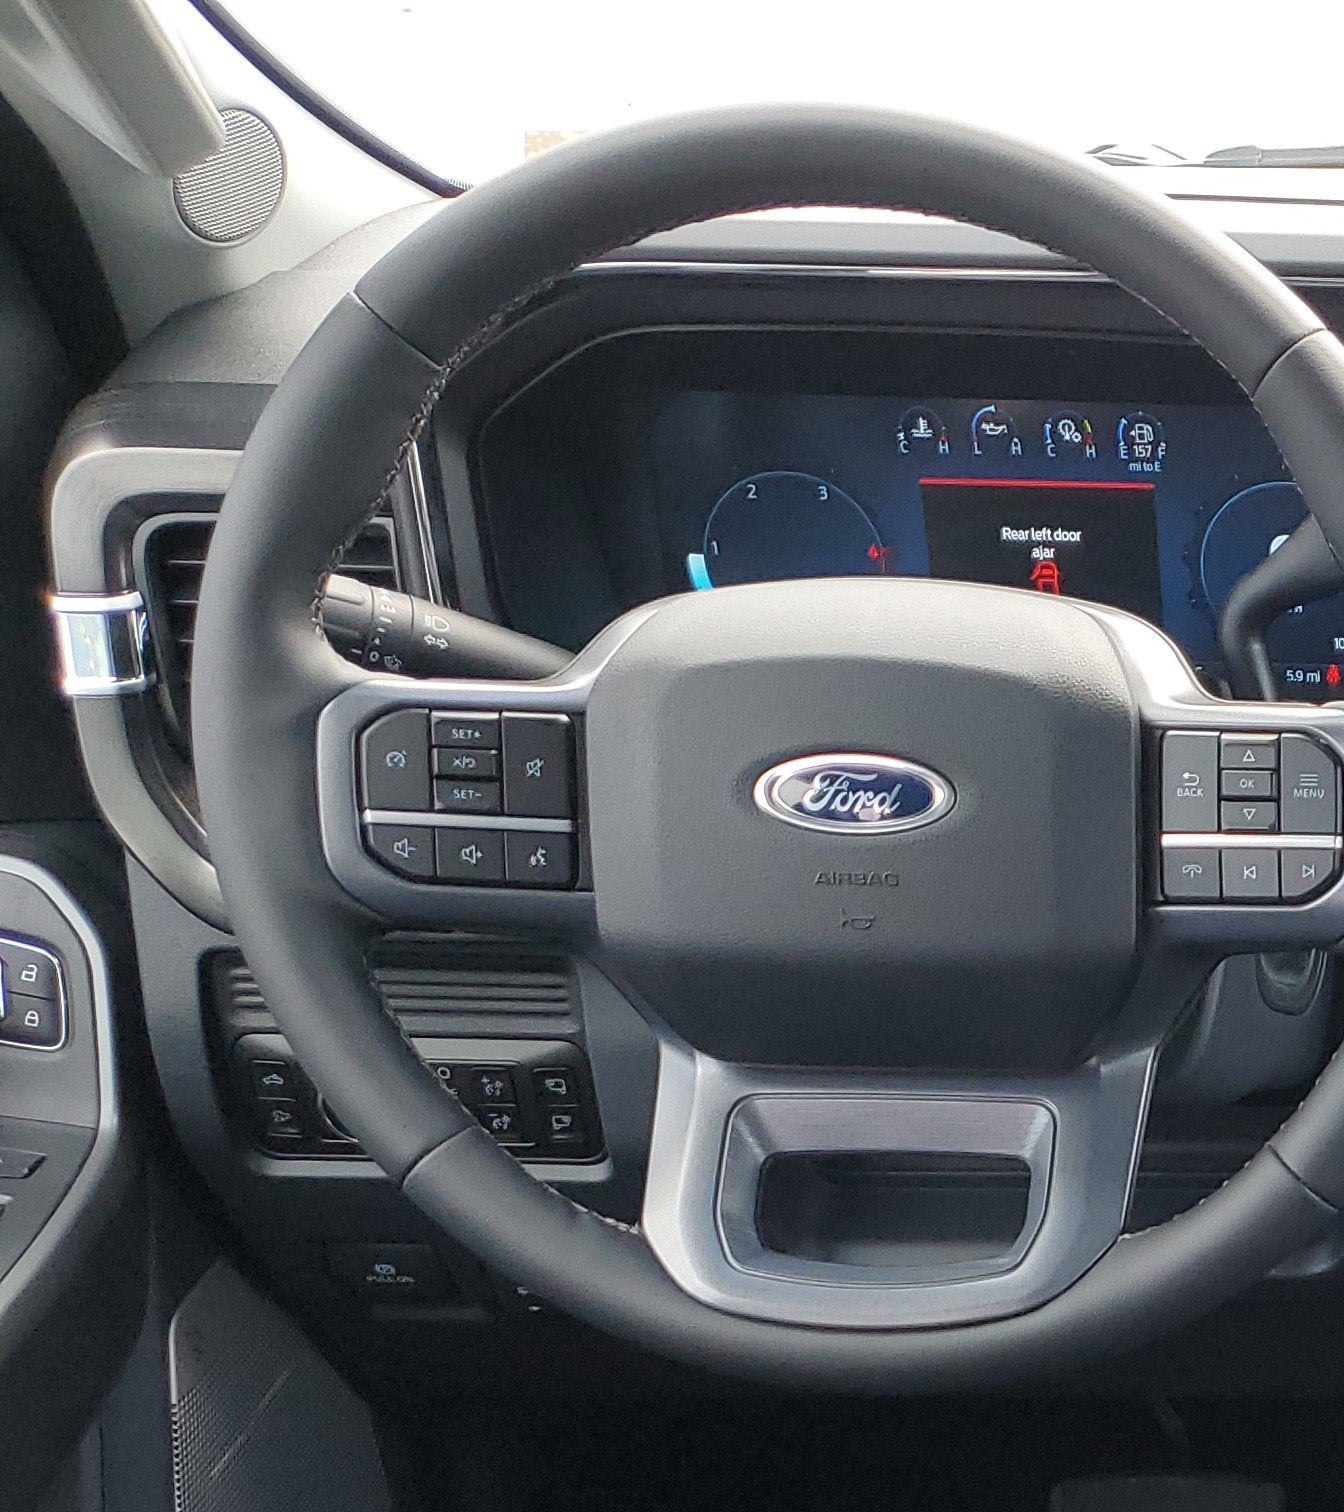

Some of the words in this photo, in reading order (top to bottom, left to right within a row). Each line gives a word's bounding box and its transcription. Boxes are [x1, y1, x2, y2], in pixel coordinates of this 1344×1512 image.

[1119, 446, 1129, 459] E
[1132, 444, 1152, 458] 157
[1143, 462, 1154, 471] to
[1154, 462, 1162, 472] E
[746, 484, 758, 500] 2
[817, 486, 829, 501] 3
[1001, 526, 1030, 541] Rear
[1031, 526, 1053, 542] left
[1053, 526, 1082, 542] door
[711, 540, 719, 556] 1
[1031, 545, 1056, 560] ajar
[1285, 669, 1304, 682] 5.9
[1306, 669, 1321, 684] mi
[1239, 778, 1255, 788] OK
[801, 770, 902, 814] Ford
[1176, 787, 1204, 798] BACK
[1293, 788, 1325, 798] MENU
[813, 871, 900, 887] AIRBAG
